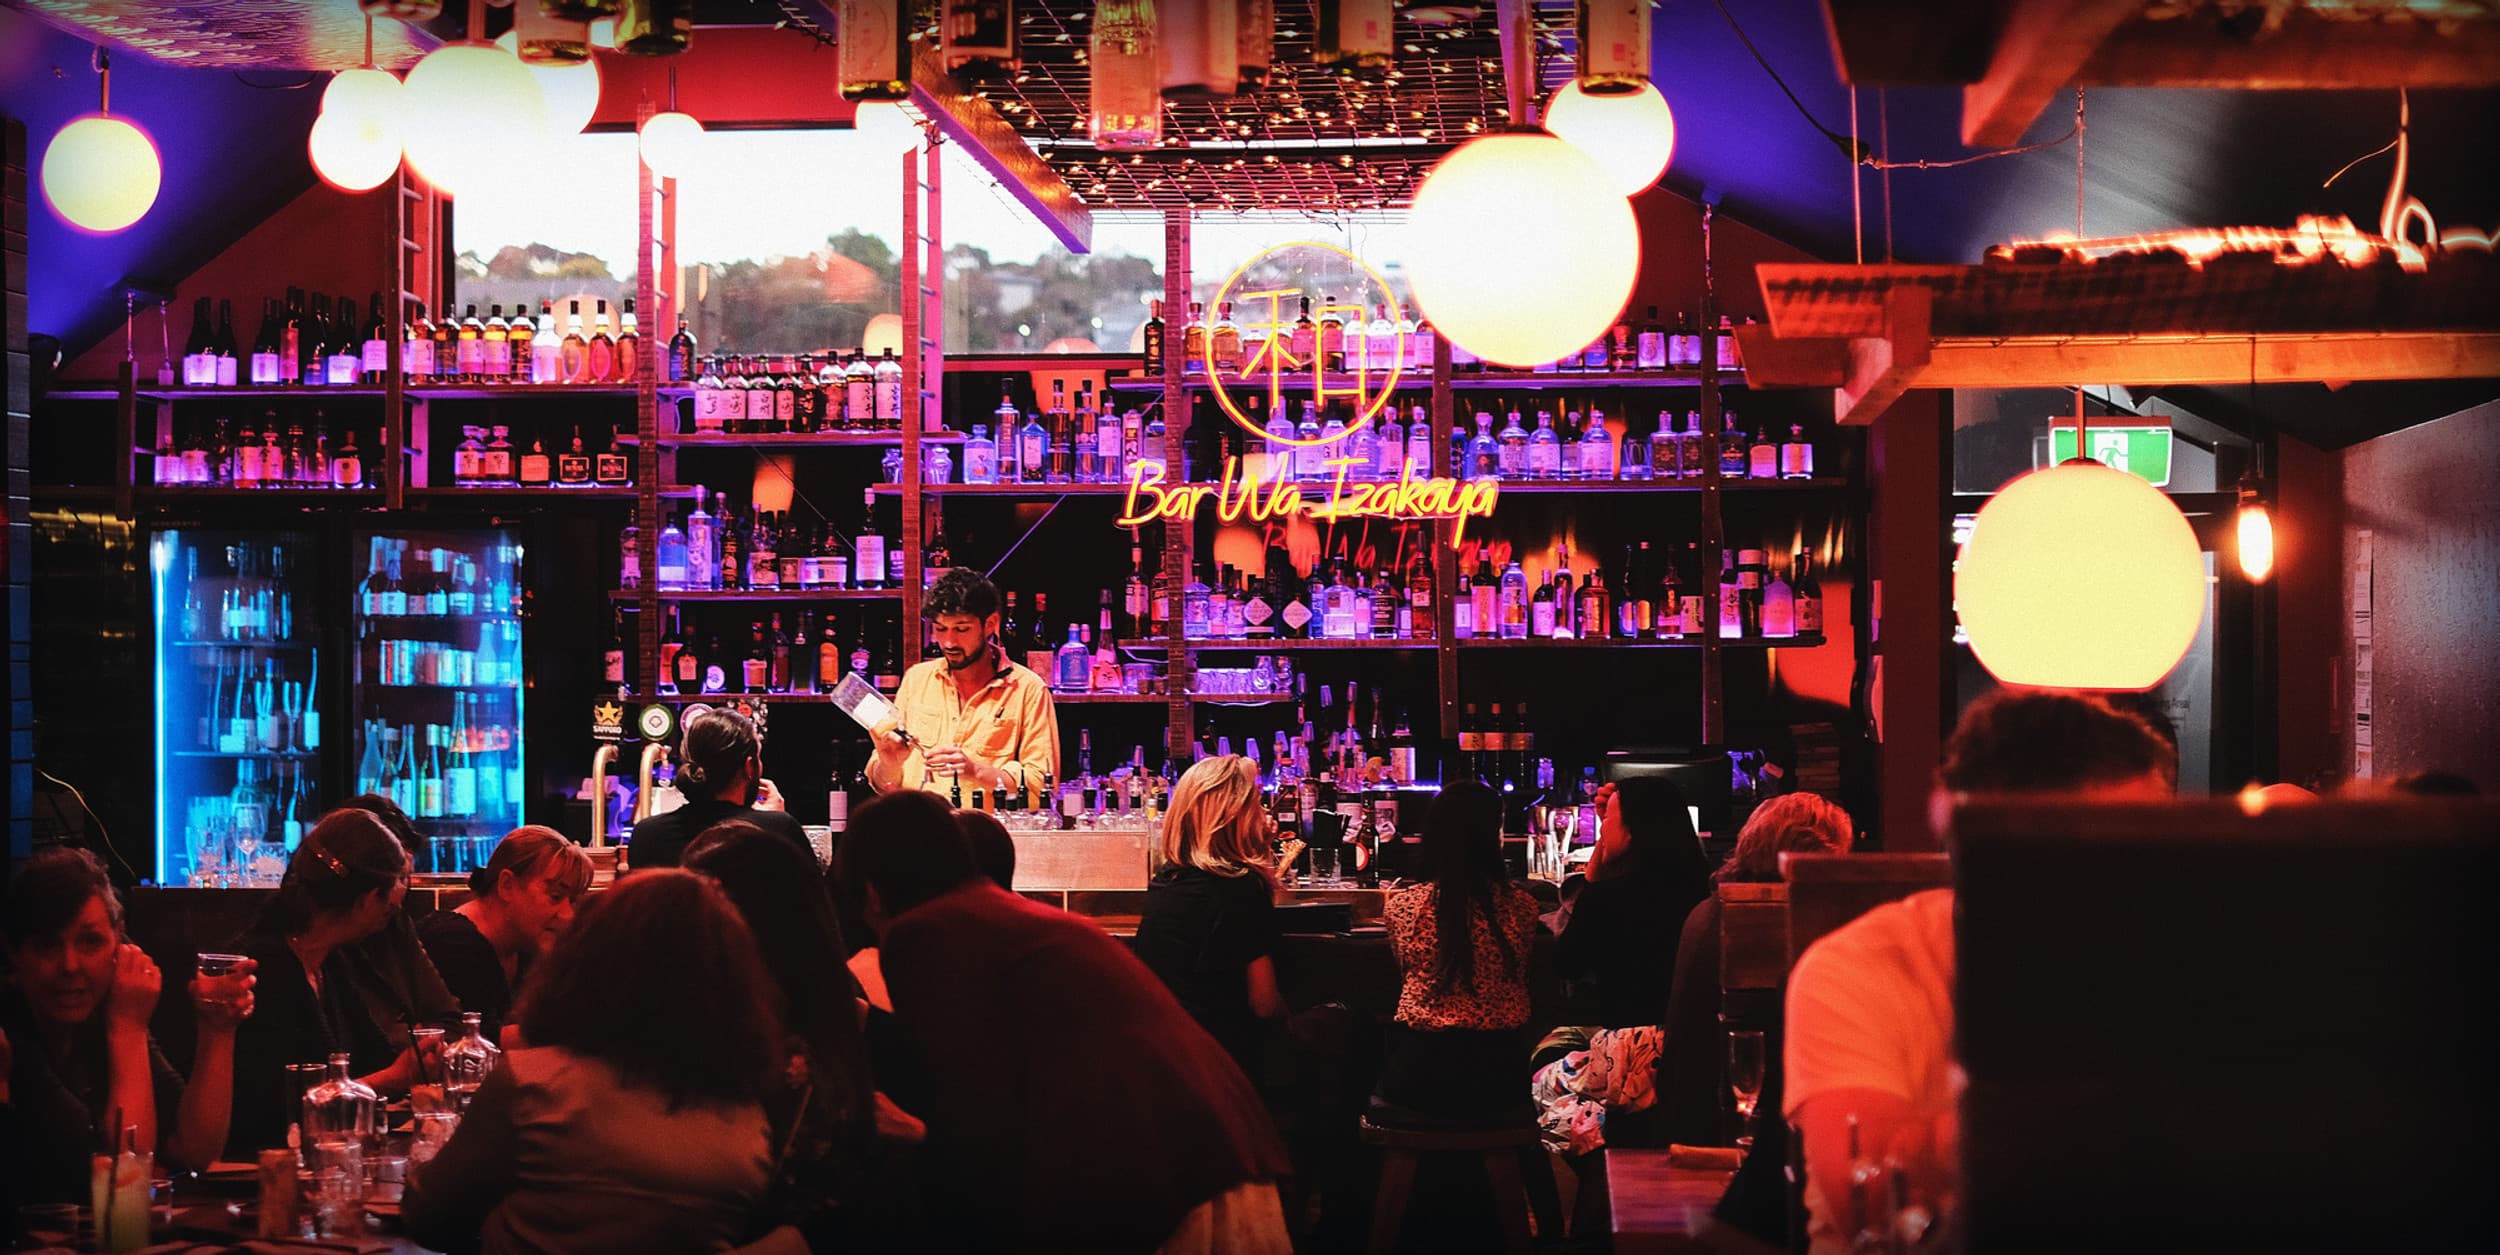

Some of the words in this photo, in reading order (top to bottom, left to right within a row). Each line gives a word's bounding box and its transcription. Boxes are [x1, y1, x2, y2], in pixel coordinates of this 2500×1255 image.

[1240, 288, 1366, 408] 和
[1117, 458, 1211, 524] Bar
[1217, 456, 1301, 522] Wa
[1311, 456, 1498, 549] Izakaya
